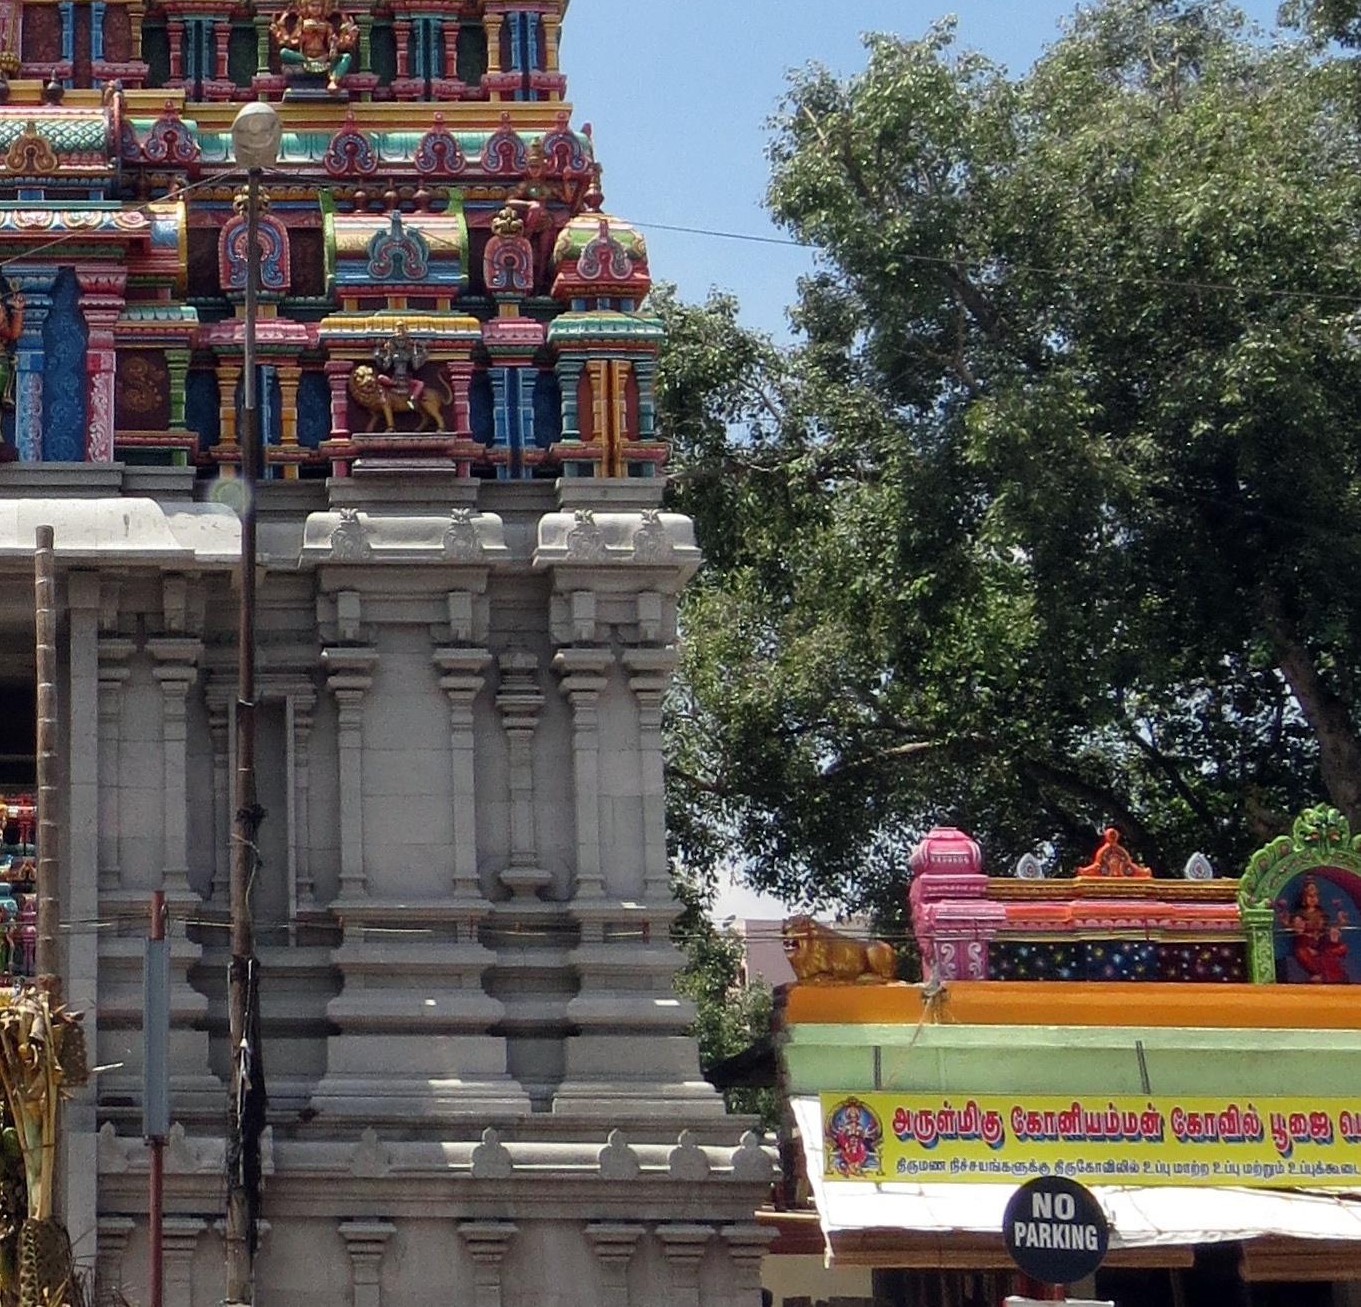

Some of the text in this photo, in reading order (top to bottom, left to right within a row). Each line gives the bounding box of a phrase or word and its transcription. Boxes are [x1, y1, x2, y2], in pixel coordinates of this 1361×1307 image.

[892, 1099, 1004, 1149] அருள்மிகு
[1011, 1101, 1163, 1142] கோனியம்மன்
[1170, 1103, 1263, 1143] கோவில்
[1270, 1111, 1334, 1157] பூஜை
[896, 1156, 946, 1174] திருமண
[1032, 1192, 1075, 1221] NO
[1014, 1221, 1098, 1251] PARKING
